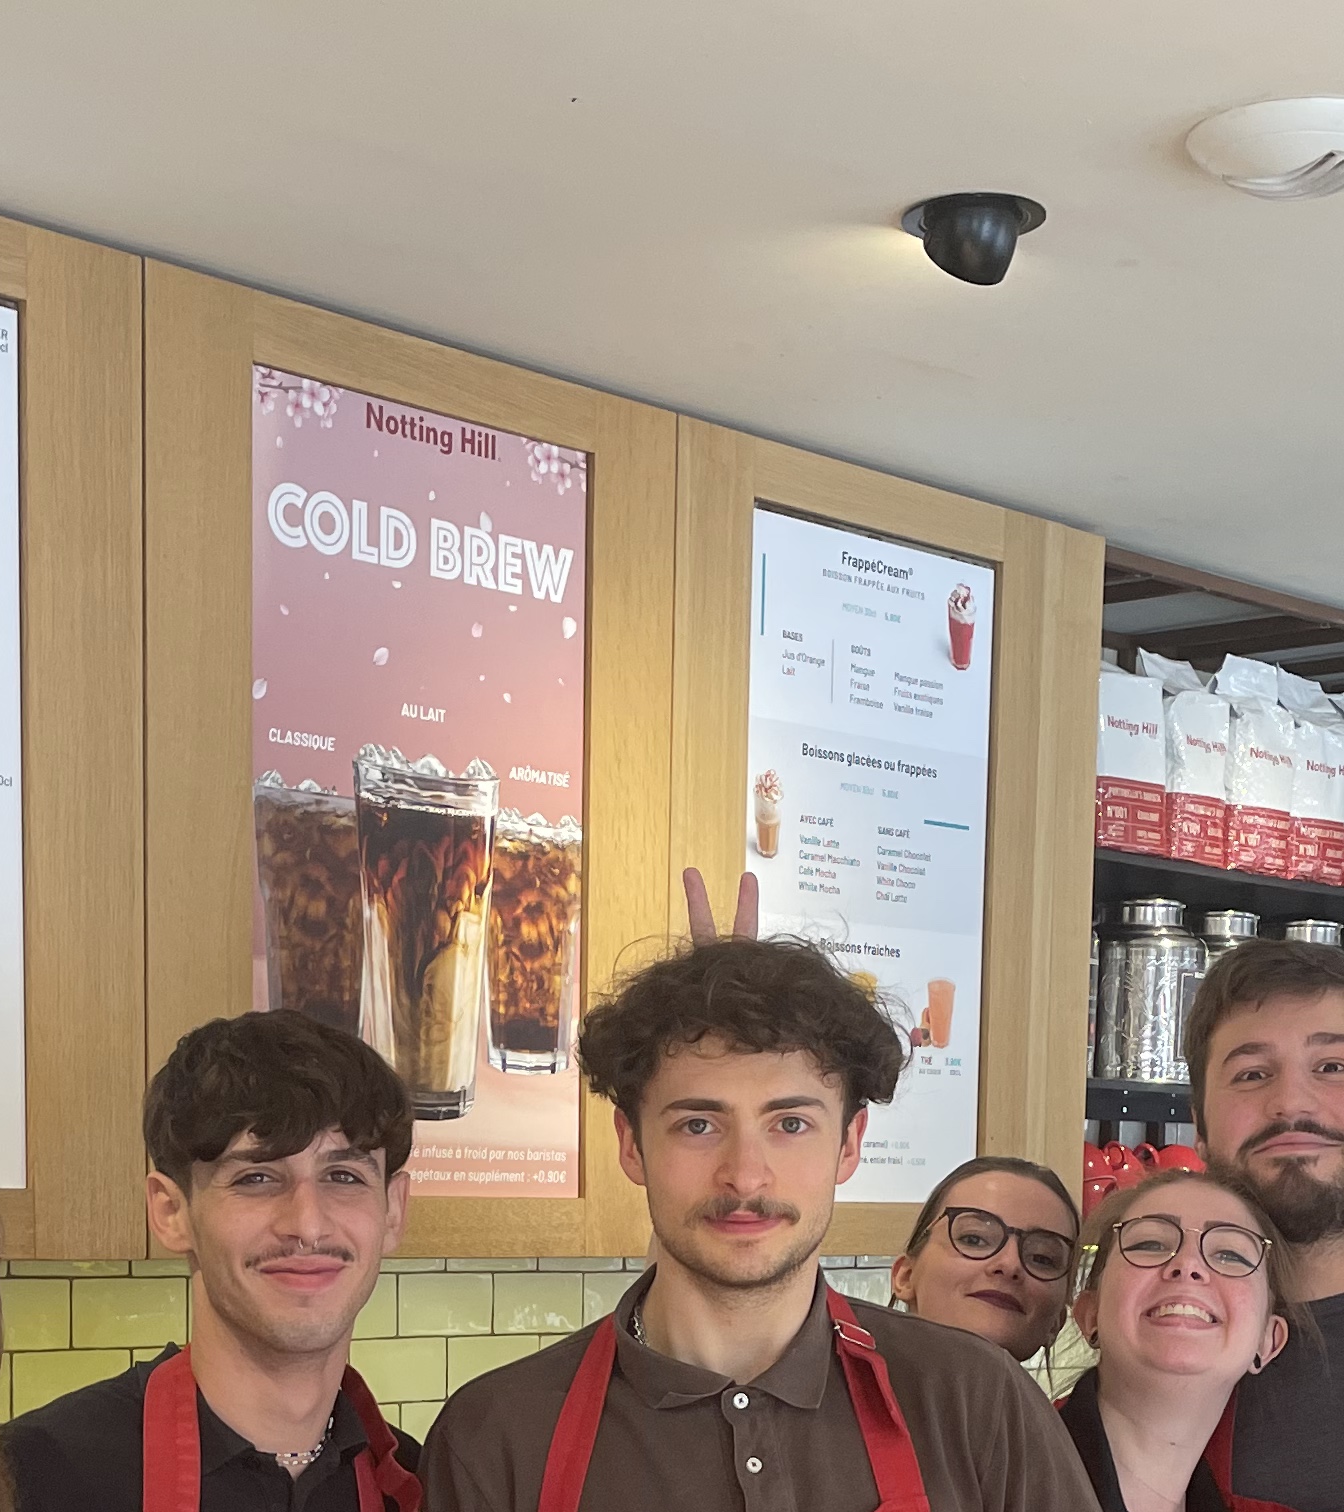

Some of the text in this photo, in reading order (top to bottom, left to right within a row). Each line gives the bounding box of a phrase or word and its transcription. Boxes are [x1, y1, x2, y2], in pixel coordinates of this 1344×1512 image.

[366, 402, 497, 460] Notting Hill
[267, 482, 574, 603] COLD BREW
[401, 702, 446, 722] AU LAIT
[1107, 715, 1158, 736] Notting Hill
[268, 727, 336, 751] CLASSIQUE
[802, 743, 938, 778] Boissons glacées ou frappées
[509, 765, 570, 788] ARÔMATISÉ
[820, 938, 861, 954] Boissons
[424, 1145, 453, 1158] infusé
[464, 1147, 487, 1160] froid
[489, 1150, 506, 1162] par
[507, 1151, 524, 1160] nos
[527, 1148, 566, 1162] baristas
[453, 1169, 524, 1184] en supplément
